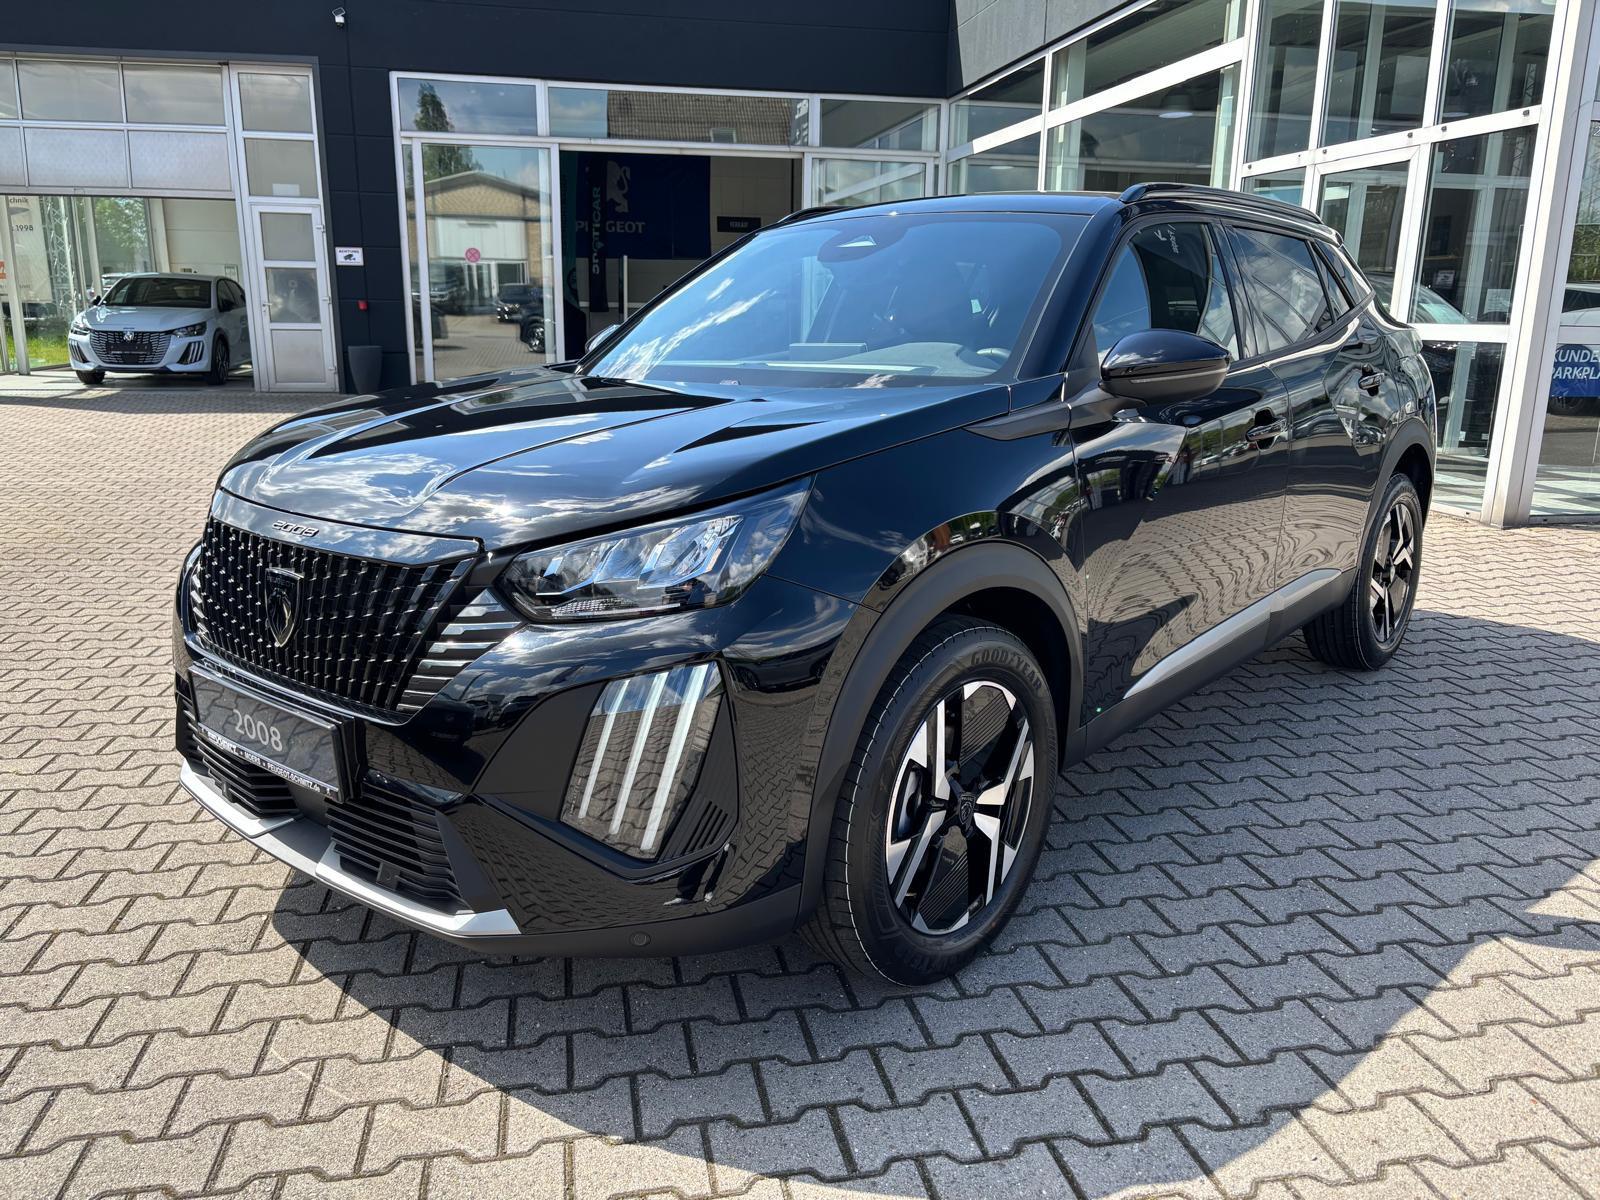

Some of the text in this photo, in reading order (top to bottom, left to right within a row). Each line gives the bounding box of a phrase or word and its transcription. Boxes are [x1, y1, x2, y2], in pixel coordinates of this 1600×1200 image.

[576, 220, 646, 234] PGEOT
[1554, 350, 1600, 363] UNDE
[271, 519, 320, 538] 2008
[232, 708, 283, 752] 2008
